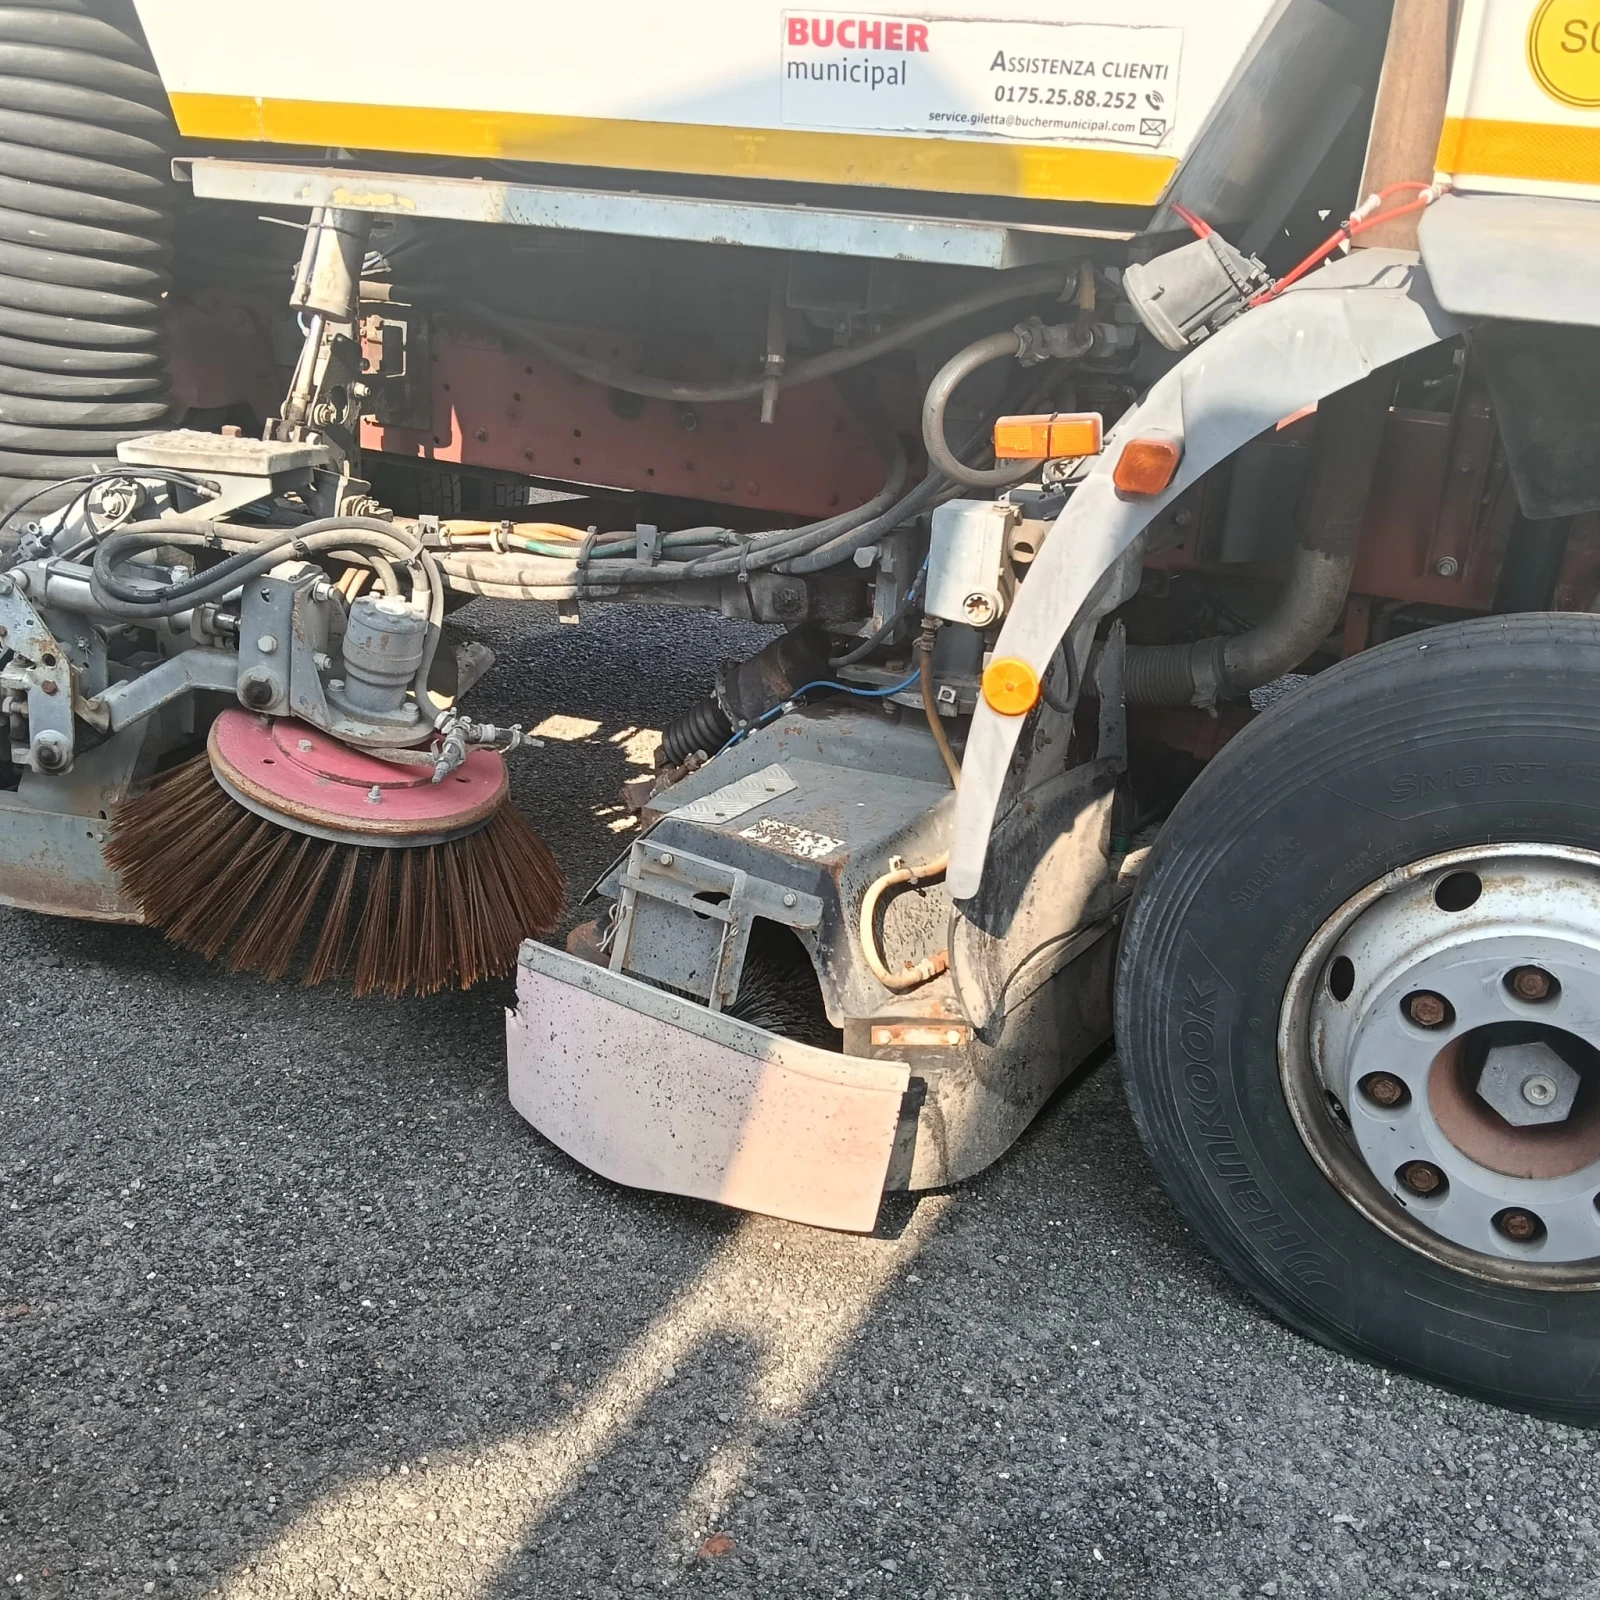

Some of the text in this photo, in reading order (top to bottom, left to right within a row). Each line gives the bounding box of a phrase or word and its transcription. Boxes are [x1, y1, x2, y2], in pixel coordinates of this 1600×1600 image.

[787, 17, 930, 53] BUCHER
[786, 57, 907, 91] municipal
[990, 50, 1169, 81] ASSISTENZA CLIENTI
[994, 85, 1137, 110] 0175.25.88.252
[928, 110, 1136, 133] service.giletta@buchermunicipal.com
